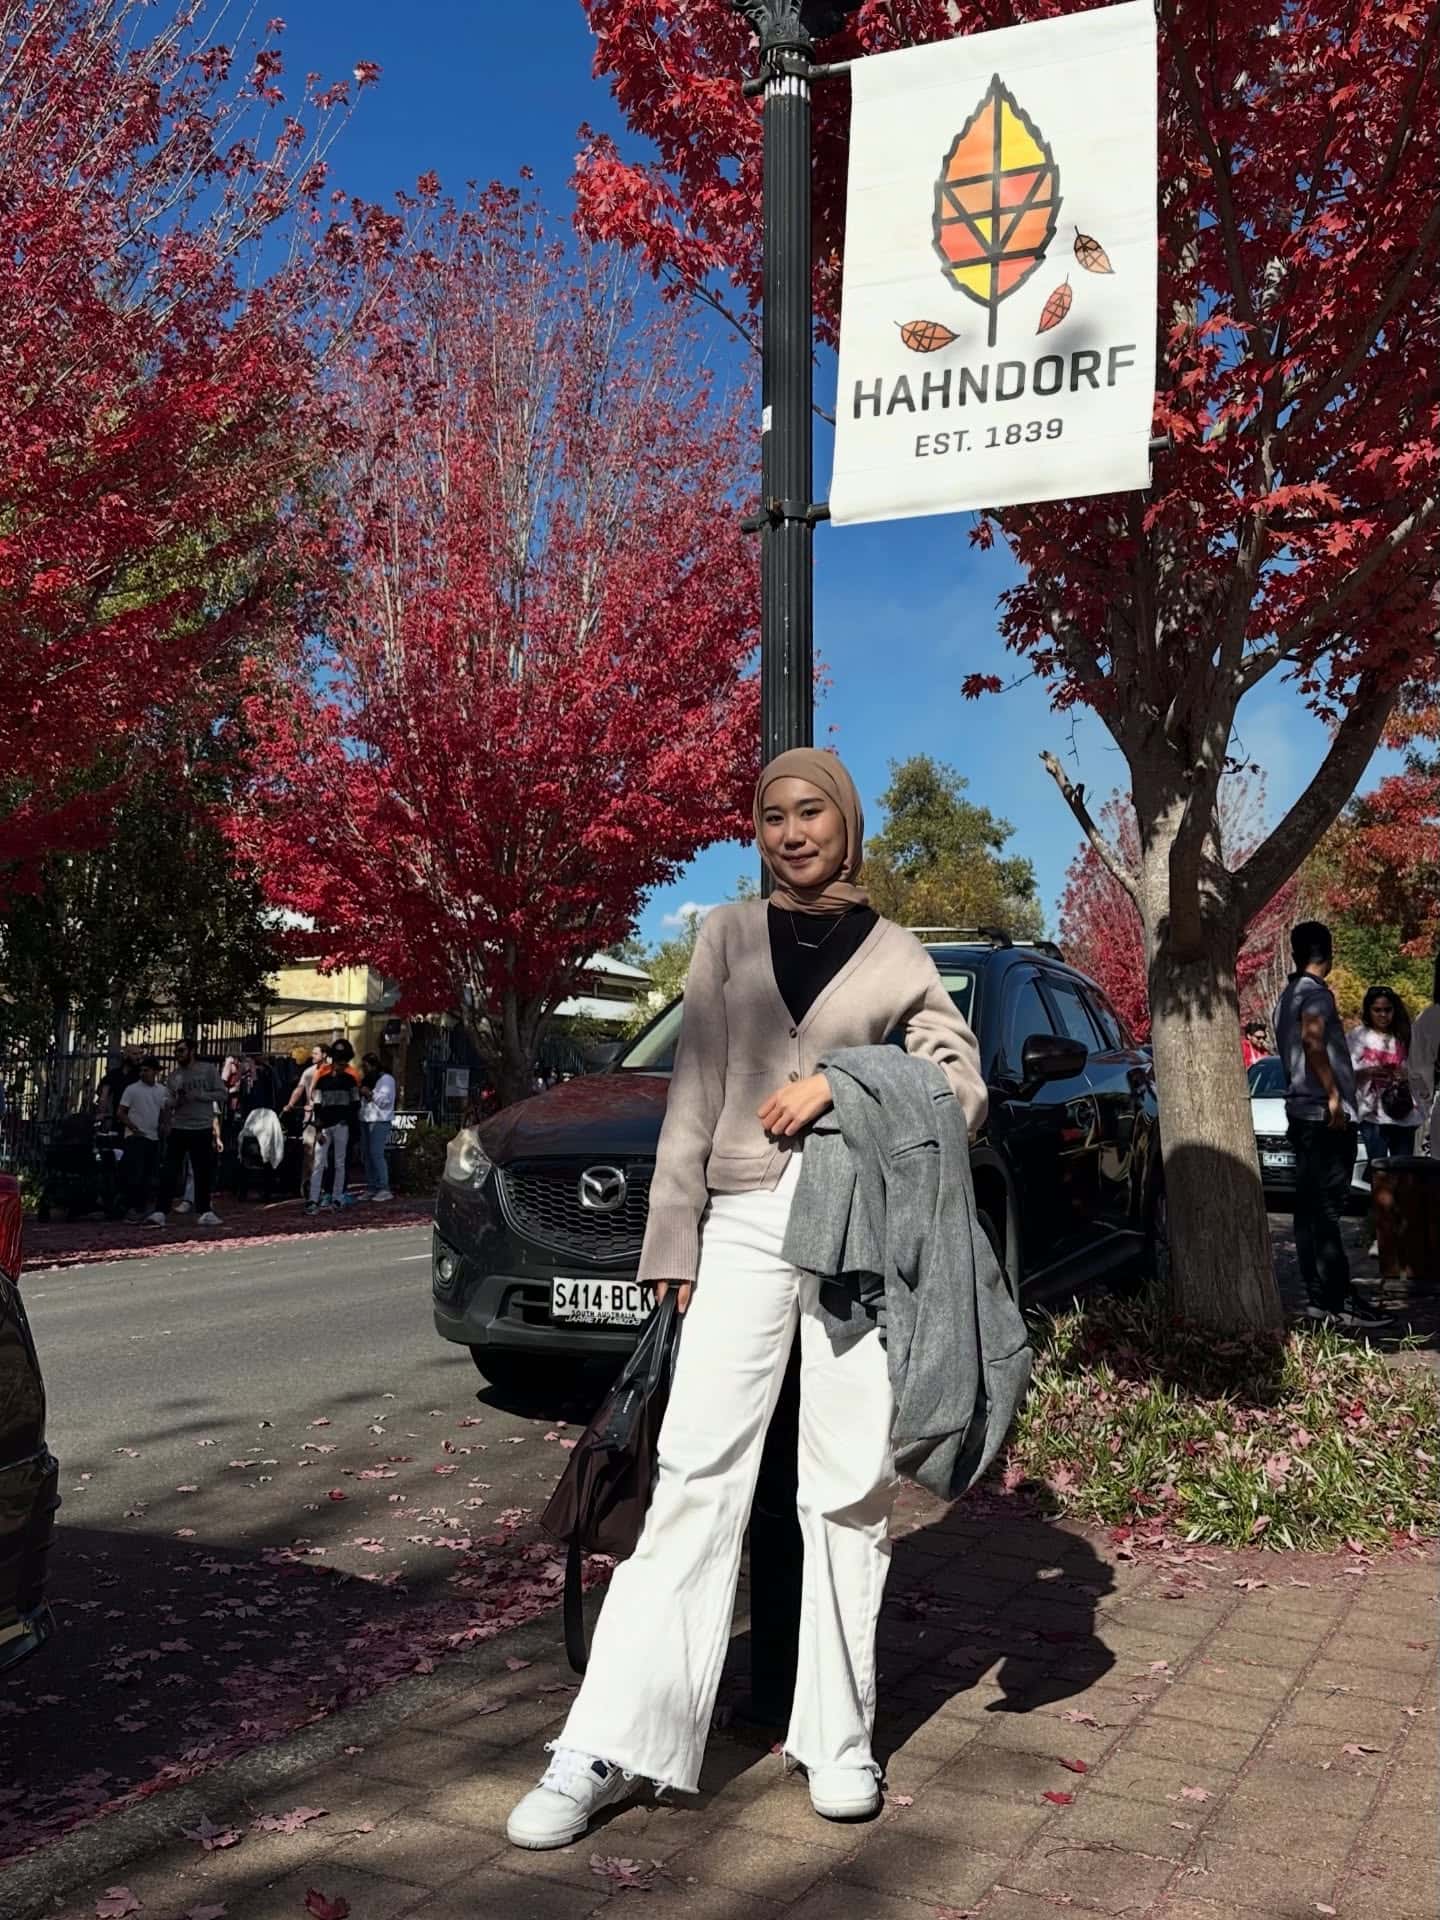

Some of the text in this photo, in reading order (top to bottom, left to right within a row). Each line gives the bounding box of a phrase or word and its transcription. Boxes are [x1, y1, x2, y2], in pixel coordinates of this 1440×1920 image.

[853, 344, 1136, 419] HAHNDORF
[915, 418, 1063, 457] EST. 1839
